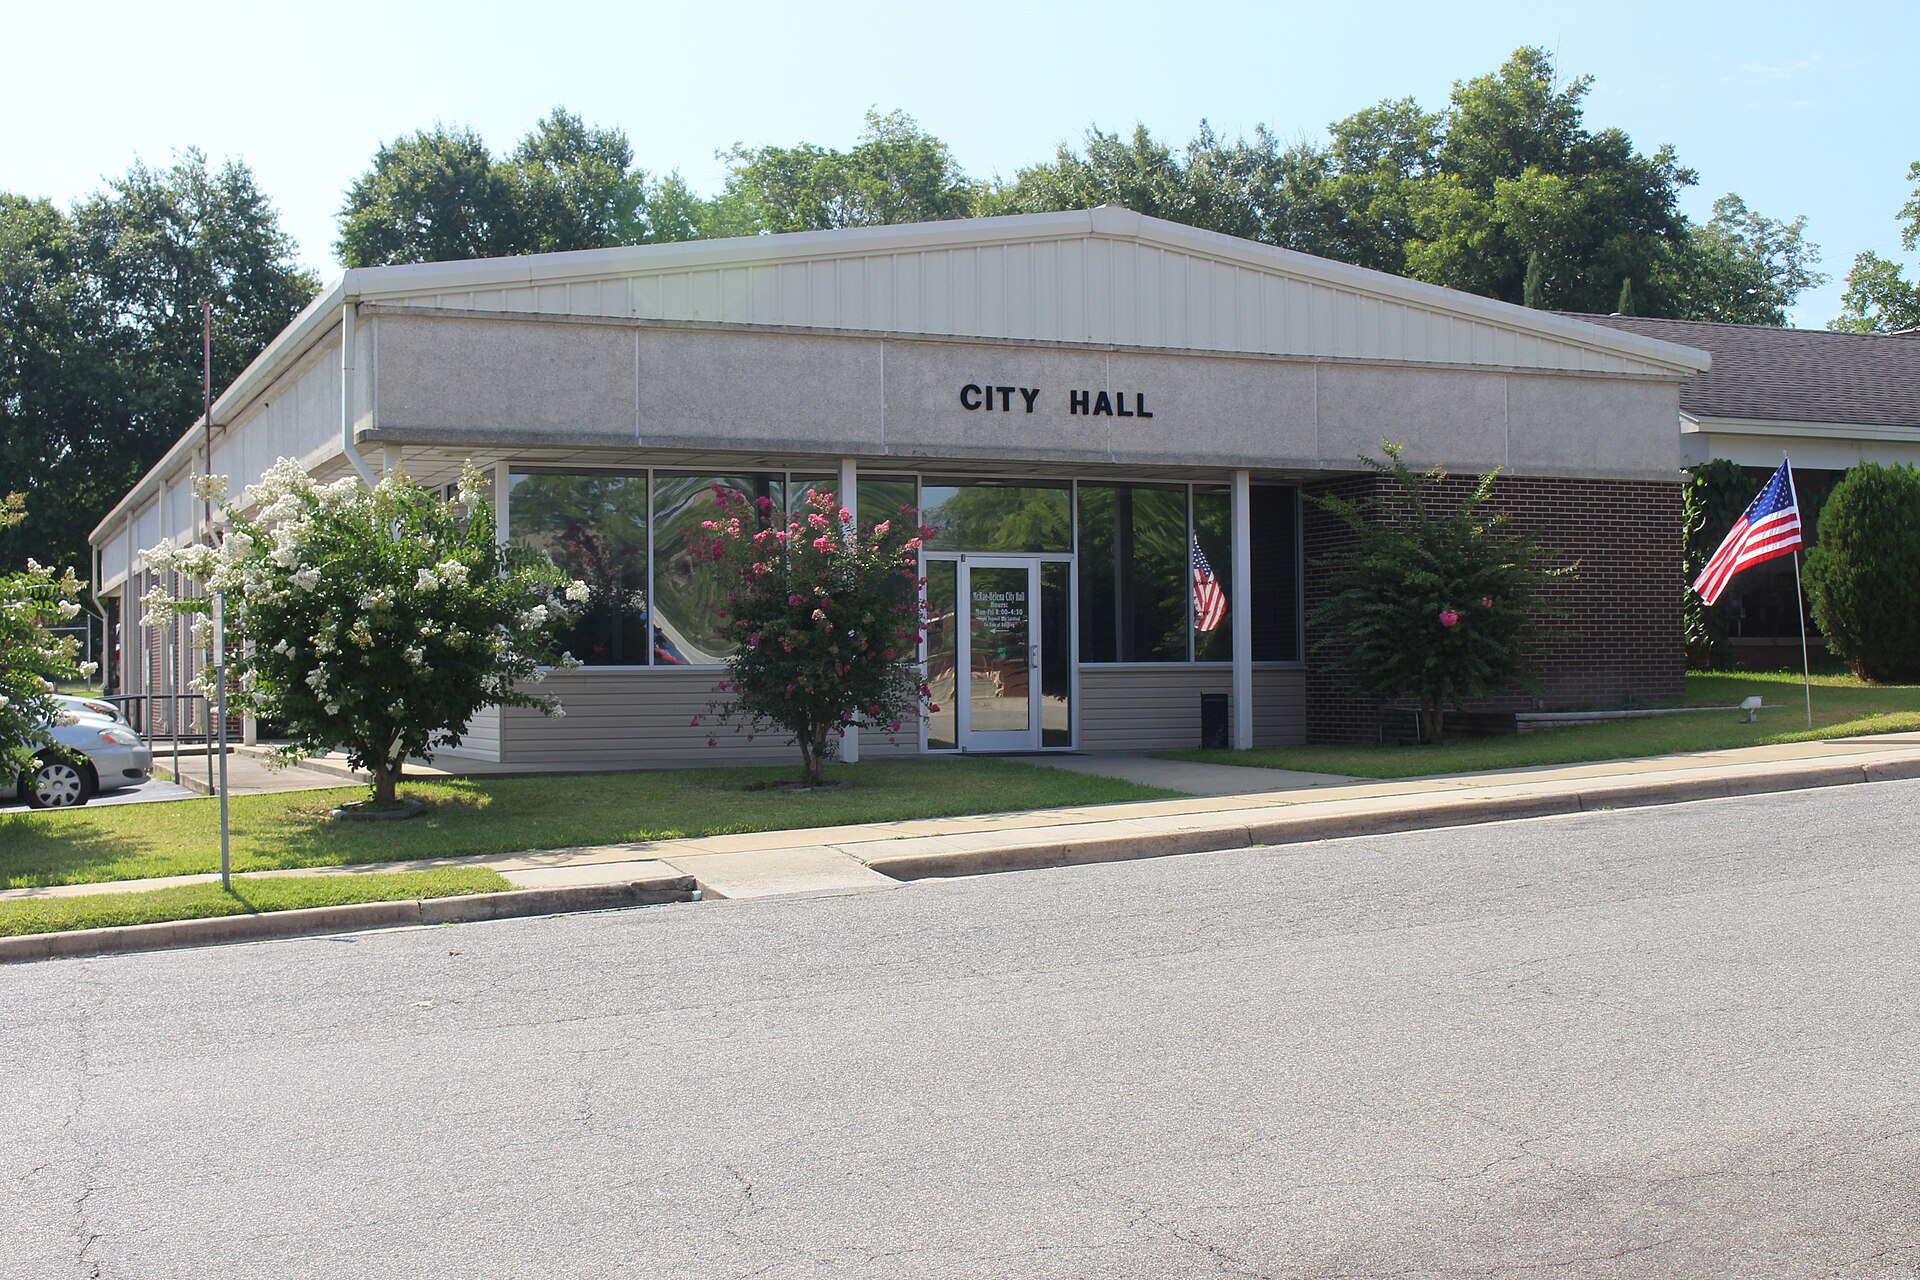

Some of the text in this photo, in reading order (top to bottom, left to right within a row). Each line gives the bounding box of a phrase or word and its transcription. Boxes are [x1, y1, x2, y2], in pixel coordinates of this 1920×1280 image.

[959, 383, 1154, 419] CITY HALL
[1005, 591, 1015, 603] City
[1016, 592, 1025, 602] Hall
